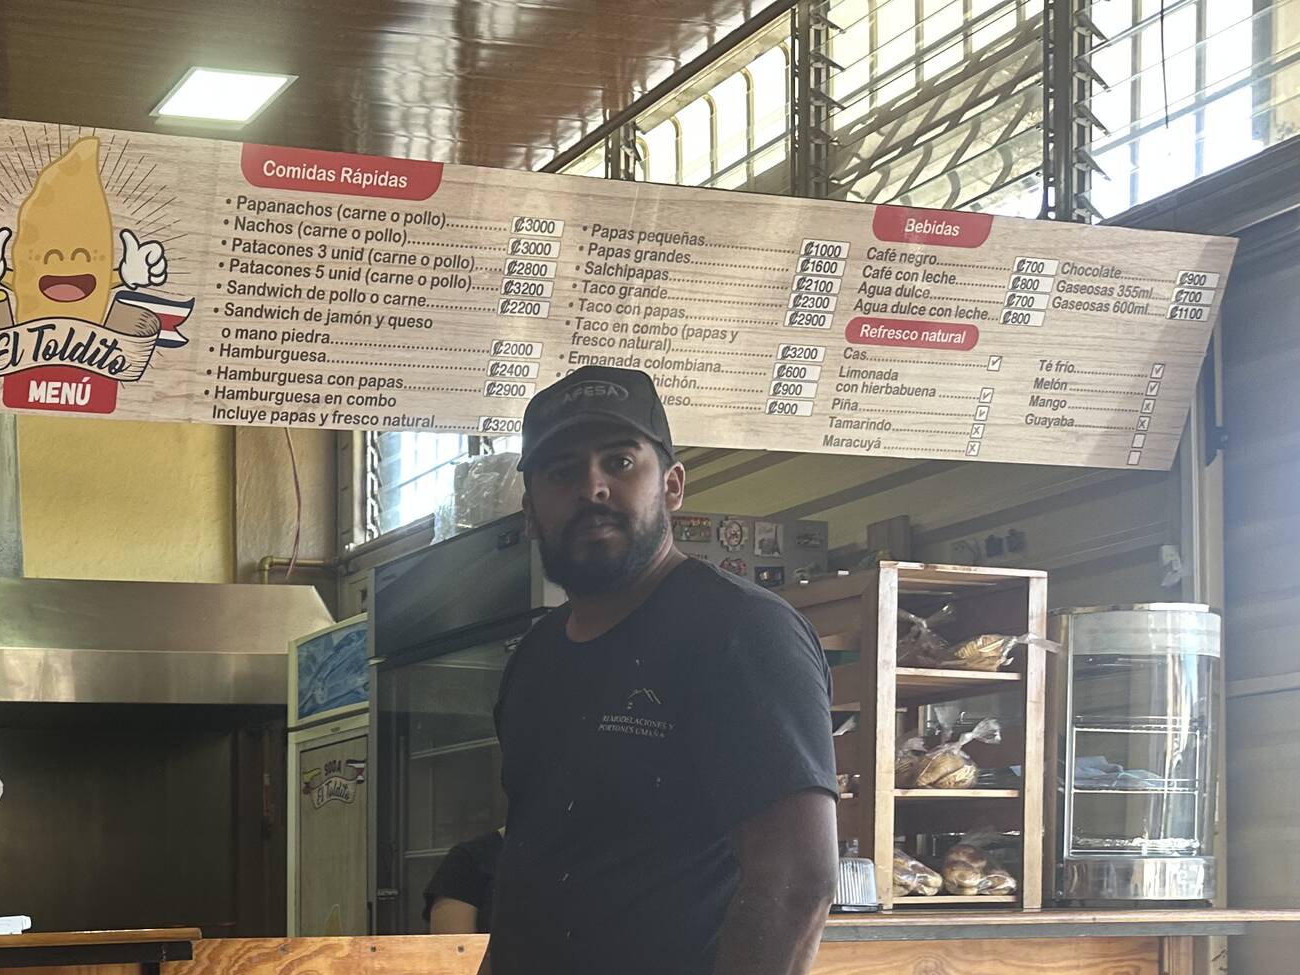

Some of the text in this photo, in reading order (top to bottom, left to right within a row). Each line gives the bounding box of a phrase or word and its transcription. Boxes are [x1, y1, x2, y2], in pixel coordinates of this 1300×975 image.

[263, 160, 408, 189] Comidas Rápidas
[237, 195, 332, 217] Papanachos
[391, 210, 399, 221] o
[591, 223, 634, 242] Papas
[905, 218, 960, 236] Bebidas
[232, 238, 313, 258] Patacones
[318, 244, 327, 258] 3
[331, 246, 364, 261] unid
[421, 254, 430, 266] o
[588, 243, 630, 260] Papas
[867, 247, 896, 261] Café
[863, 265, 892, 279] Café
[896, 271, 918, 281] con
[581, 280, 616, 295] Taco
[858, 281, 891, 298] Agua
[1056, 280, 1114, 297] Gaseosas
[1052, 297, 1110, 313] Gaseosas
[224, 302, 433, 329] Sandwich de jamón y queso
[221, 327, 230, 338] o
[235, 327, 277, 340] mano
[860, 324, 966, 344] Refresco natural
[27, 324, 131, 375] Toldito
[569, 352, 640, 369] Empanada
[1039, 360, 1052, 372] Té
[839, 366, 899, 381] Limonada
[28, 377, 91, 405] MENÚ
[836, 382, 858, 393] con
[214, 386, 396, 408] Hamburguesa en combo
[212, 406, 266, 423] Incluye
[270, 410, 316, 424] papas
[319, 413, 328, 426] y
[332, 411, 379, 426] fresco
